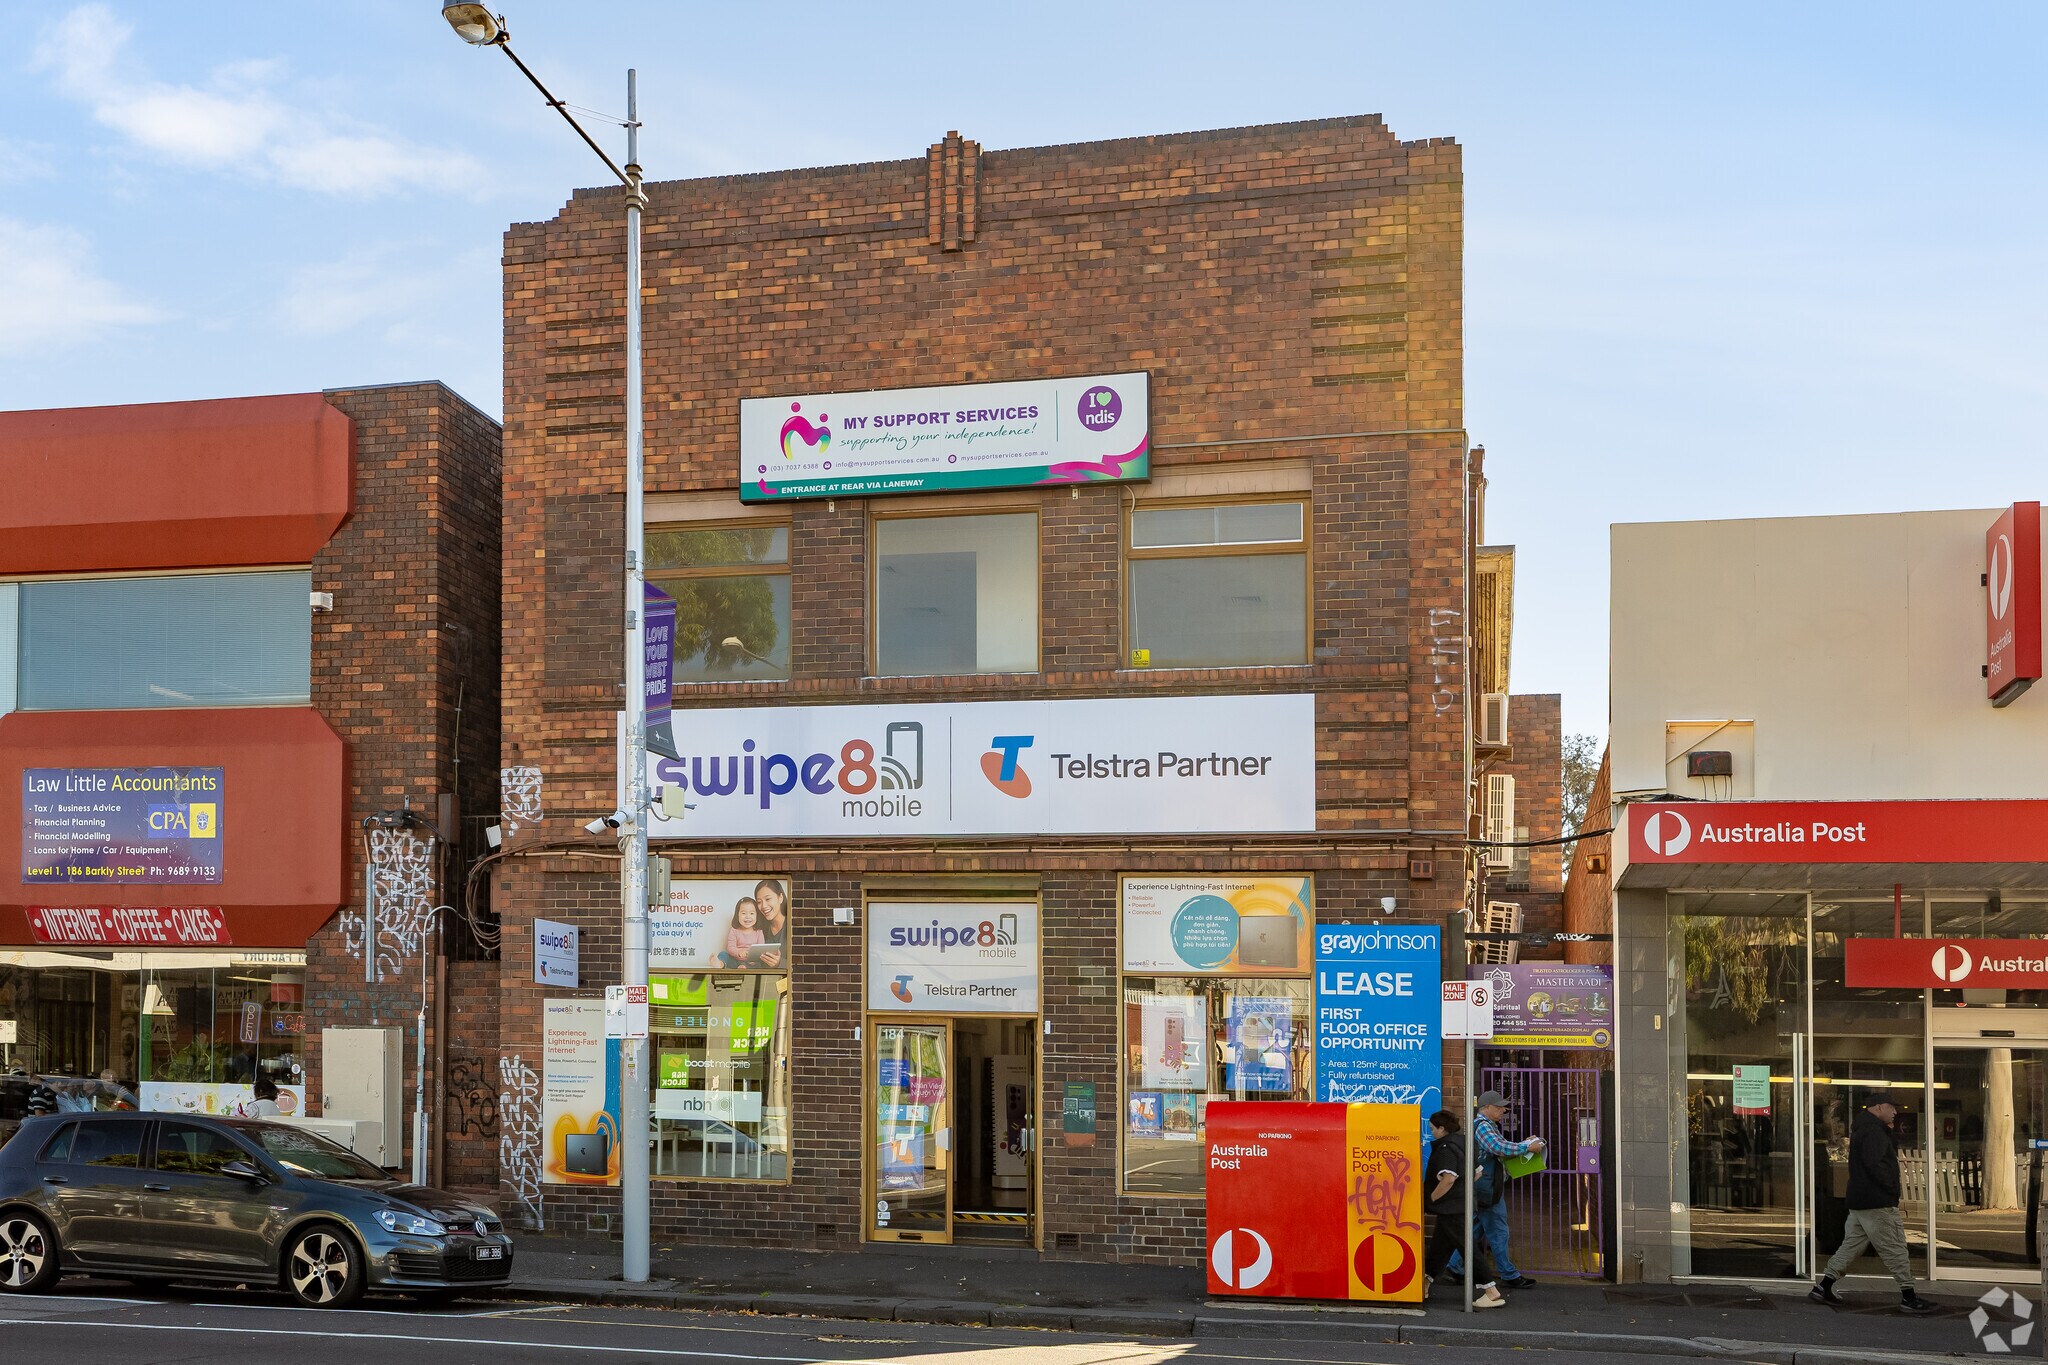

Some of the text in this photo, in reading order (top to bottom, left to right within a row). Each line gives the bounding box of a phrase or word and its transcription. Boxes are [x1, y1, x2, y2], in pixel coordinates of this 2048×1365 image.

[844, 406, 1038, 430] MY SUPPORT SERVICES
[1086, 410, 1115, 424] ndis
[839, 422, 1038, 450] supporting your independence!
[835, 457, 940, 468] info@mysupportservices.com.au
[960, 450, 1049, 461] mysupportservices.com.au
[781, 485, 826, 494] ENTRANCE
[883, 480, 924, 488] LANEWAY
[646, 625, 668, 644] LOVE
[1991, 628, 2011, 659] Australia
[645, 644, 668, 662] YOUR
[644, 661, 667, 679] WEST
[1991, 657, 2002, 678] Post
[645, 679, 667, 696] PRIDE
[1050, 752, 1272, 779] Telstra Partner
[656, 738, 877, 810] swipe8
[28, 774, 216, 792] Law Little Accountants
[58, 804, 91, 812] Business
[92, 804, 121, 812] Advice
[842, 795, 922, 817] mobile
[34, 818, 106, 828] Financial Planning
[150, 812, 188, 830] CPA
[72, 832, 110, 842] Modelling
[1700, 822, 1866, 842] Australia Post
[126, 846, 168, 856] Equipment
[28, 866, 215, 878] Level 1, 186 Barkly Street Ph: 9689 9133
[670, 890, 690, 900] eak
[664, 905, 714, 914] language
[41, 908, 217, 941] INTERNET COFFEE CAKES
[540, 932, 568, 950] swipe8
[890, 920, 996, 953] swipe8
[1320, 931, 1436, 954] grayjohnson
[979, 947, 1017, 958] mobile
[1979, 956, 2048, 972] Austral
[1320, 972, 1413, 996] LEASE
[1536, 978, 1601, 986] MASTER AADI
[924, 984, 1017, 997] Telstra Partner
[548, 1006, 569, 1015] swipe8
[1320, 1008, 1362, 1020] FIRST
[246, 1004, 256, 1041] OPEN
[285, 1014, 306, 1033] Coffe
[1320, 1023, 1427, 1036] FLOOR OFFICE
[548, 1029, 586, 1037] Experience
[883, 1029, 904, 1040] 184
[548, 1038, 598, 1046] Lightning-Fast
[1320, 1037, 1425, 1050] OPPORTUNITY
[1328, 1071, 1394, 1080] Fully refurbished
[683, 1097, 712, 1111] nbn
[1211, 1144, 1268, 1157] Australia
[1352, 1147, 1404, 1160] Express
[1211, 1158, 1240, 1170] Post
[1353, 1161, 1382, 1173] Post
